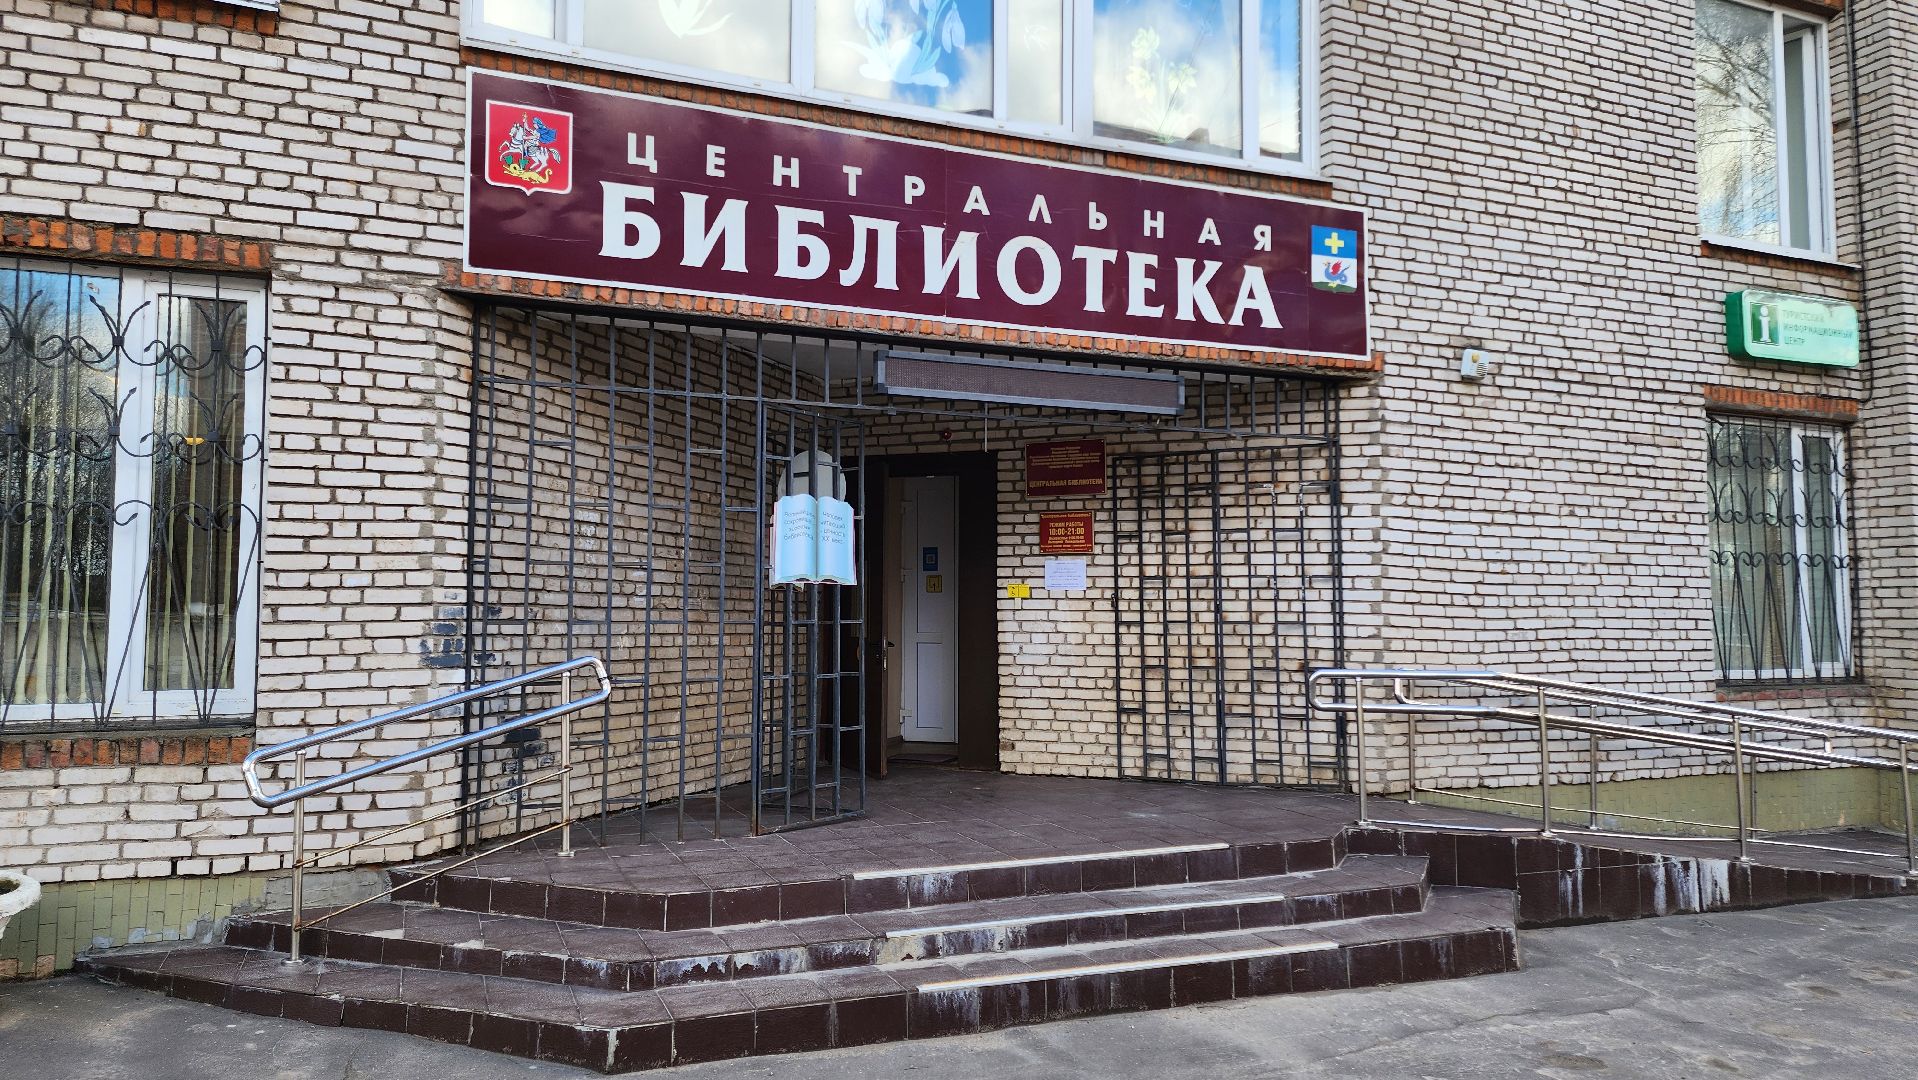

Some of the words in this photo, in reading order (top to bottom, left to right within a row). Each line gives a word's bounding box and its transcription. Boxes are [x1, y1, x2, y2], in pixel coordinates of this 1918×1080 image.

[626, 131, 1273, 253] ЦЕНТРАЛЬНАЯ
[597, 180, 1284, 330] БИБЛИОТЕКА
[1784, 335, 1805, 345] ЦЕНТР
[1049, 527, 1085, 536] 10:00-21:00
